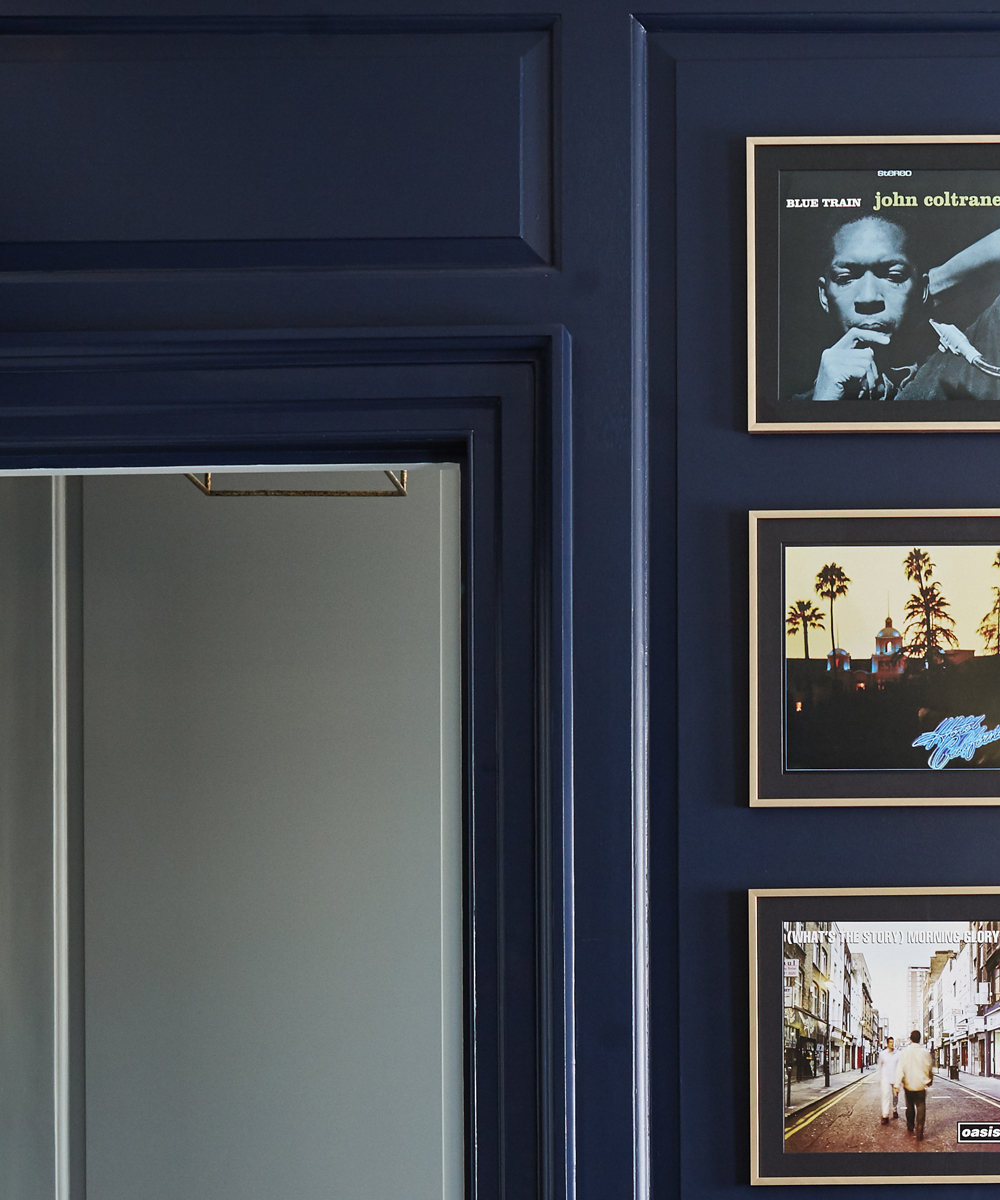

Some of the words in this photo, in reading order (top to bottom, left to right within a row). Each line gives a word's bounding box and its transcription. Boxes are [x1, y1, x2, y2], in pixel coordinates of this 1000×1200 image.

[786, 198, 819, 208] BLUE
[822, 198, 861, 208] TRAIN
[873, 191, 918, 211] john
[787, 930, 836, 944] (WHAT'S
[839, 930, 860, 944] THE
[862, 930, 903, 945] STORY)
[907, 930, 960, 944] MORNING
[963, 930, 1000, 944] GLORY
[961, 1126, 1000, 1138] oasis
